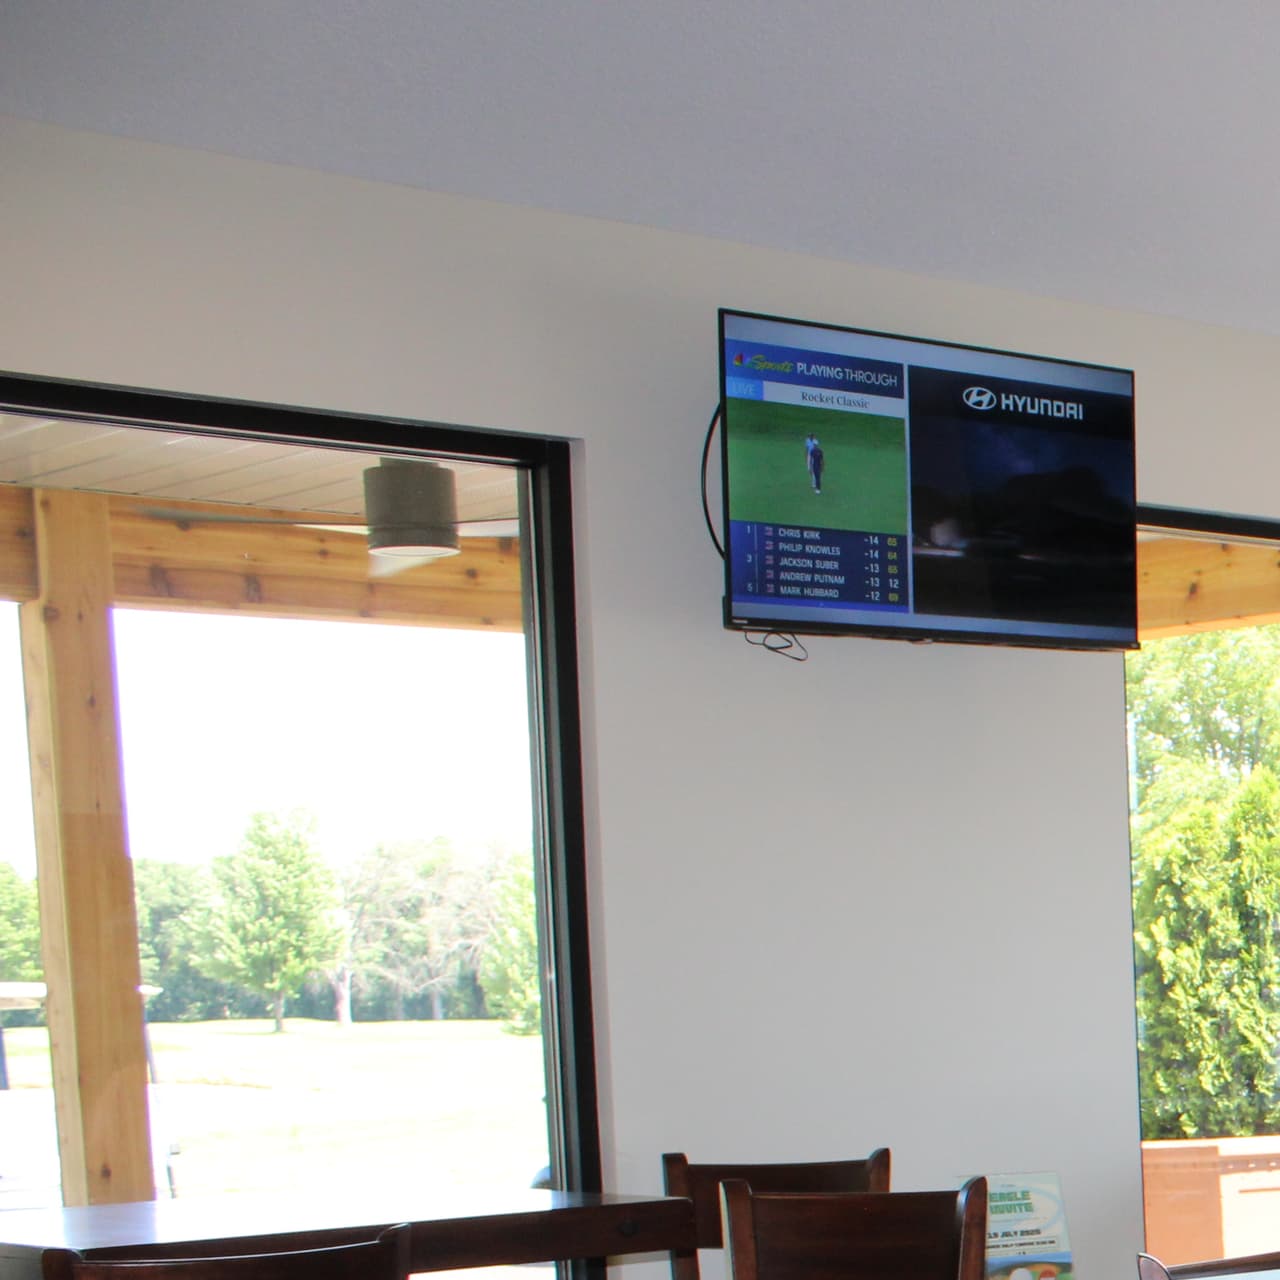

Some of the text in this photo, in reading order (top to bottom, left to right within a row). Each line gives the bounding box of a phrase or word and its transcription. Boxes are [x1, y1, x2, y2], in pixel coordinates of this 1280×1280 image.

[749, 354, 898, 387] Sports PLAYING THROUGH
[801, 391, 870, 409] Rocket Classic
[1000, 393, 1084, 420] HYUNDAI
[778, 528, 801, 538] CHRIS
[803, 531, 821, 540] KIRK
[863, 536, 879, 545] -14
[778, 543, 803, 553] PHILIP
[805, 545, 841, 555] KNOWLES
[864, 550, 880, 559] -14
[779, 557, 814, 568] JACKSON
[815, 561, 840, 570] SUBER
[864, 563, 880, 573] -13
[779, 571, 899, 589] ANDREW PUTNAM -13 12
[780, 585, 801, 595] MARK
[804, 588, 840, 598] HUBBARD
[865, 592, 881, 601] -12
